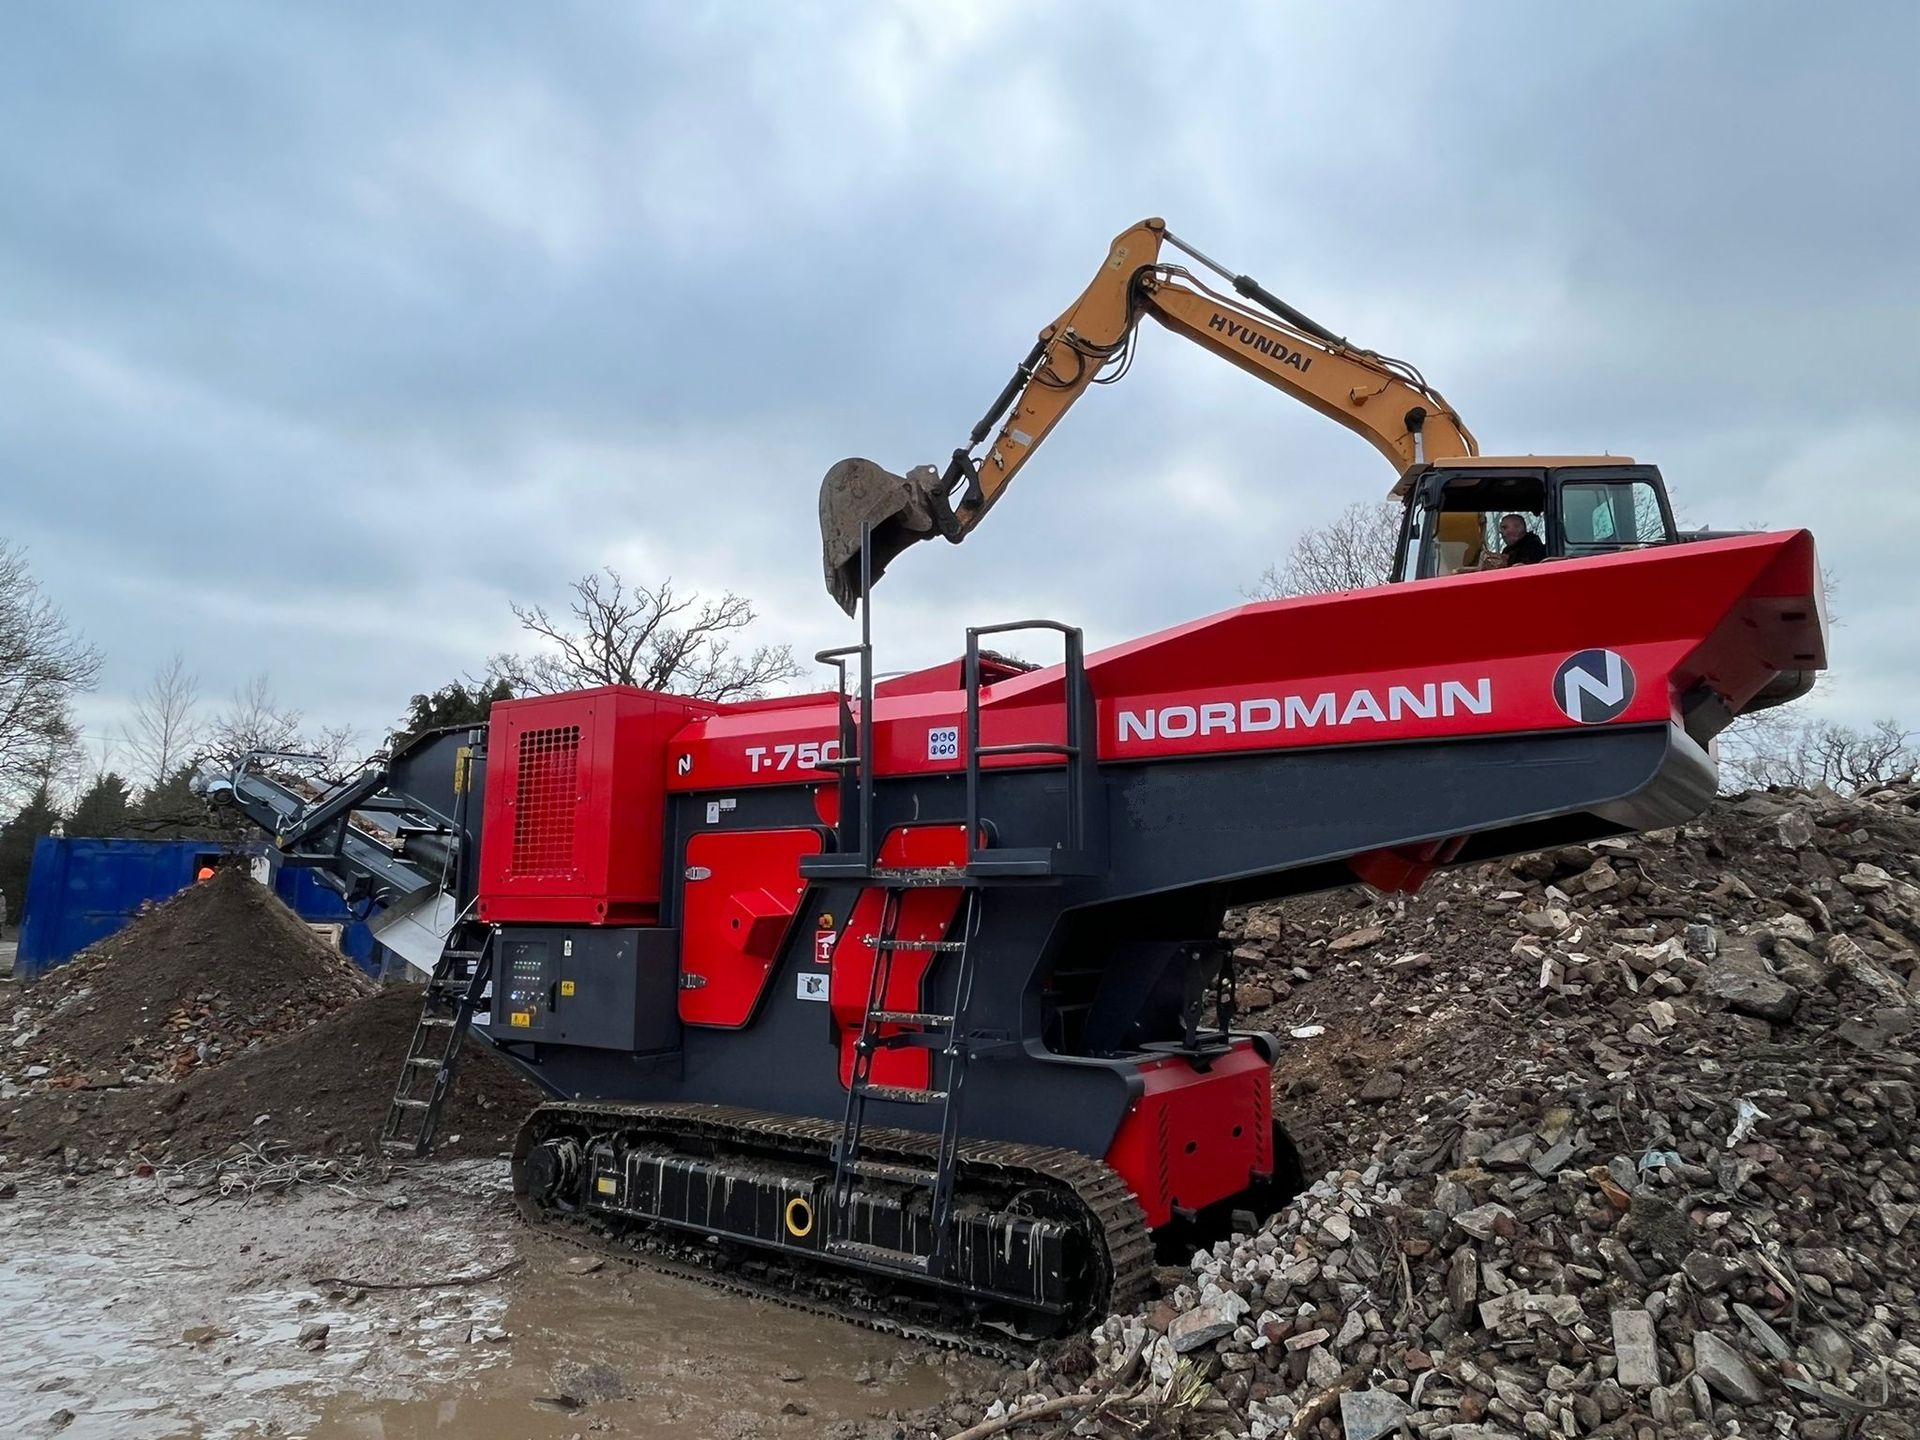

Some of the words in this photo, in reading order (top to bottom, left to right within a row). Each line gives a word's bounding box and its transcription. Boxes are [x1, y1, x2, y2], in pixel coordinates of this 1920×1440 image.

[1208, 313, 1313, 373] HYUNDAI
[1118, 677, 1493, 742] NORDMANN
[1563, 649, 1625, 722] N
